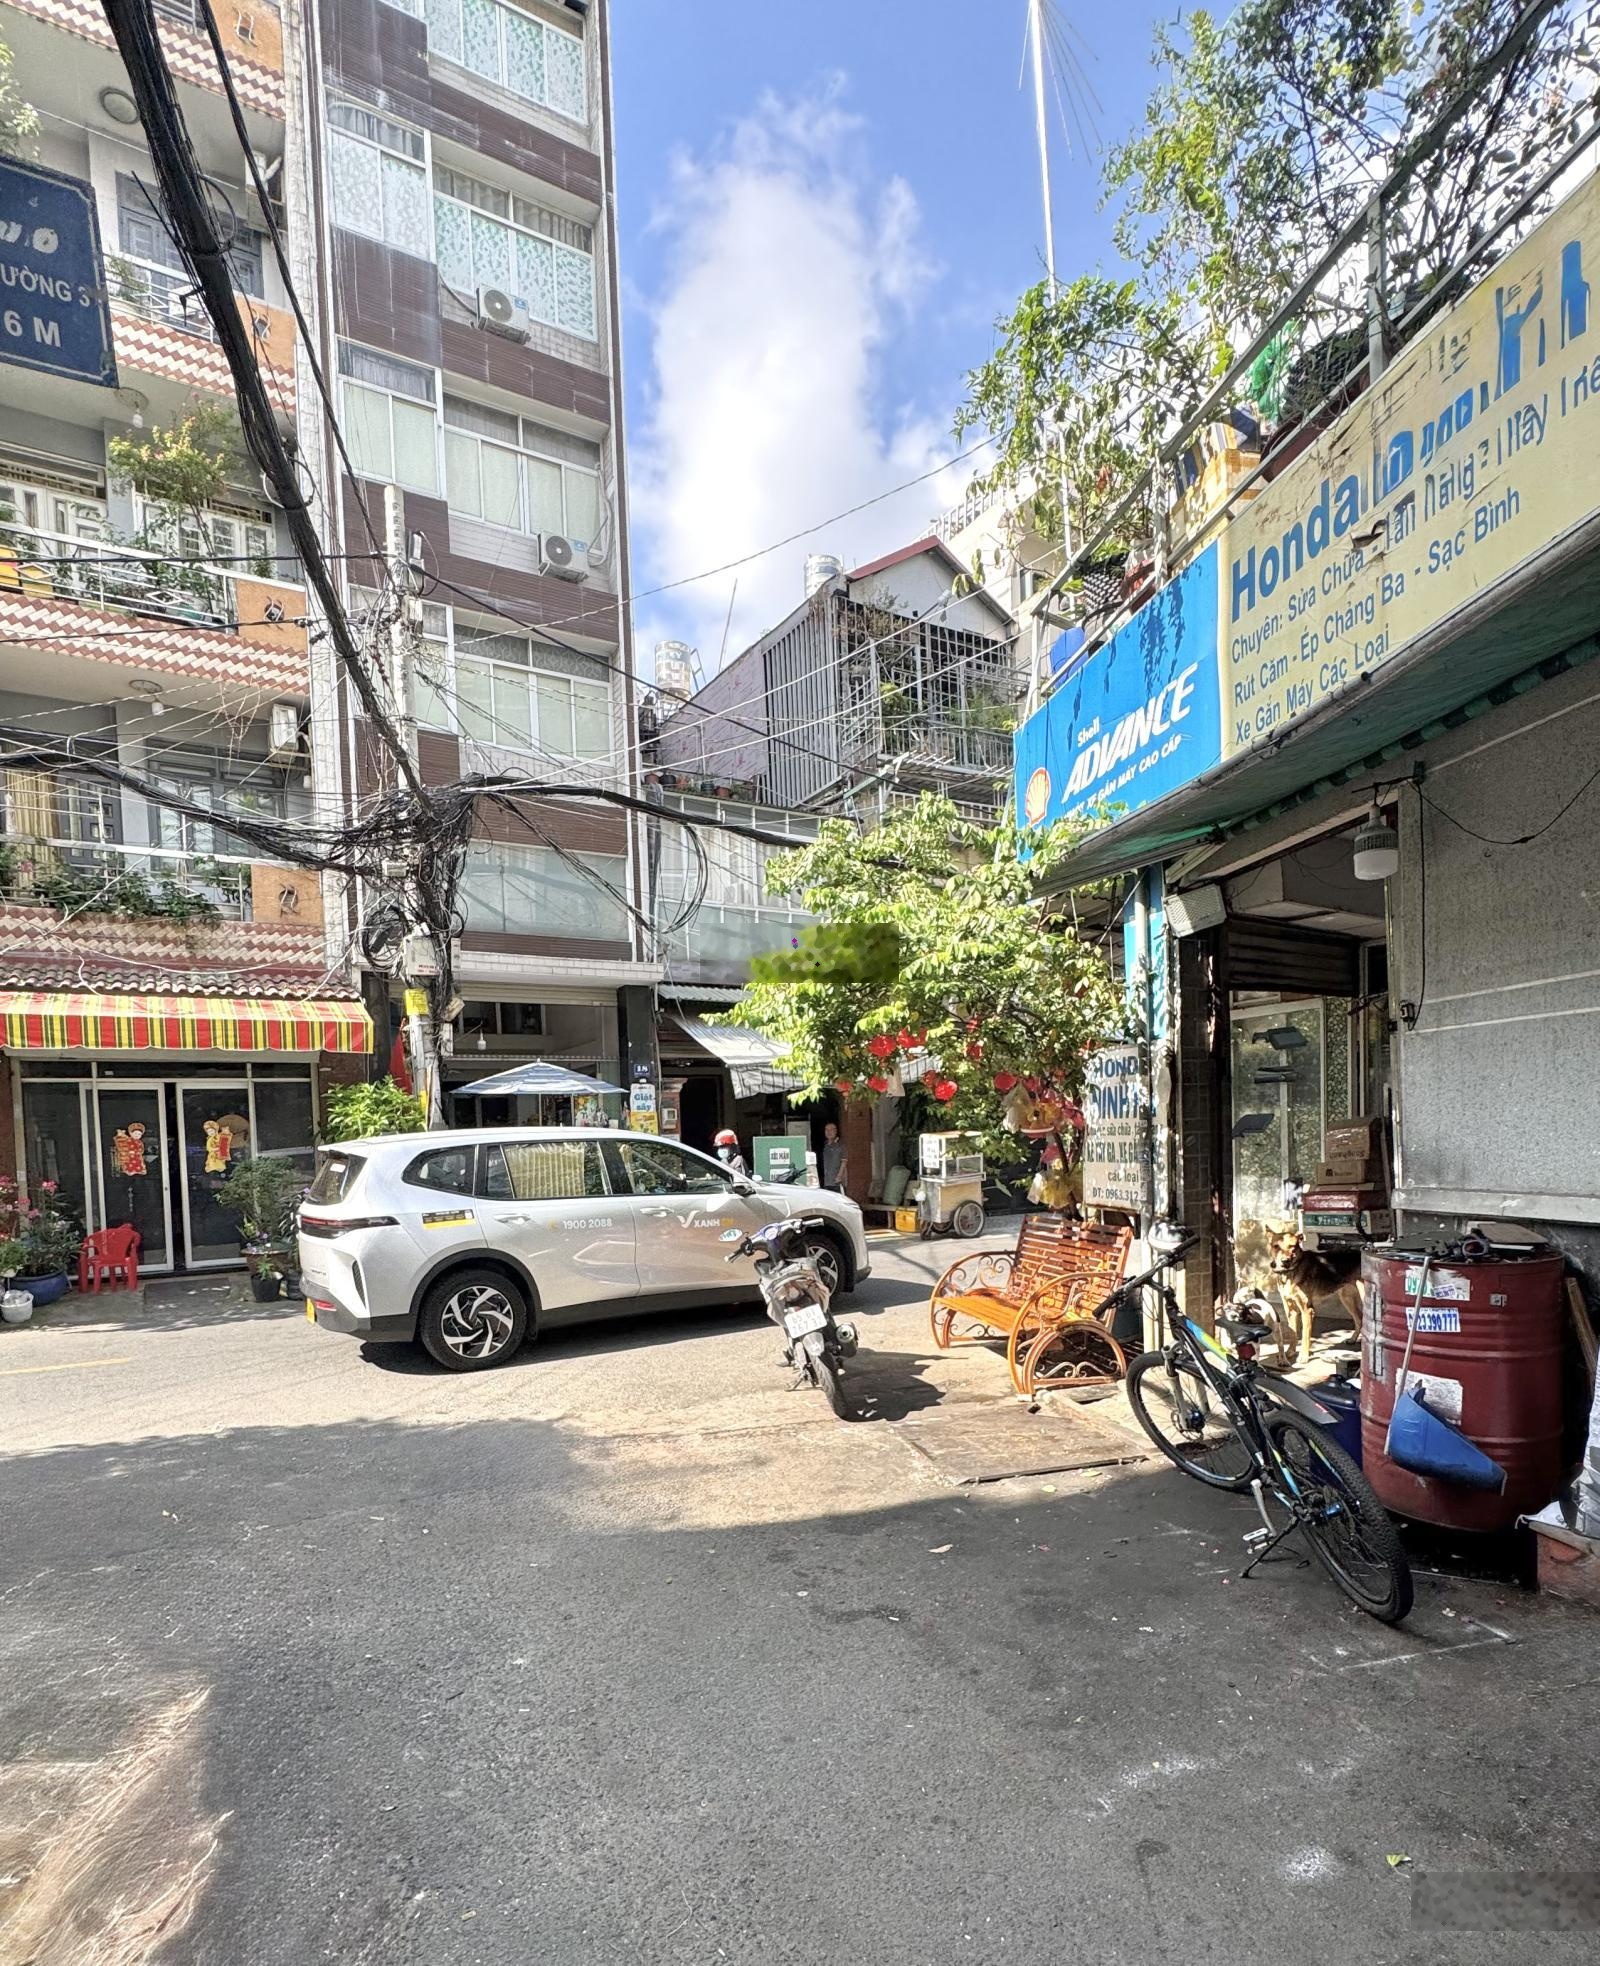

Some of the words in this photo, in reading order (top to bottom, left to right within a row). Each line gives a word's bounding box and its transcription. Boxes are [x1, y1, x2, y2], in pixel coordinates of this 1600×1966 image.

[0, 262, 72, 303] ƯỜNG
[78, 286, 90, 307] 3
[33, 317, 62, 348] M
[1231, 473, 1361, 624] Honda
[1231, 613, 1283, 664] Chuyên:
[1288, 585, 1316, 622] Sửa
[1321, 548, 1364, 596] Chữa
[1234, 673, 1256, 708] Rút
[1259, 656, 1289, 690] Căm
[1301, 625, 1319, 663] Ép
[1381, 572, 1405, 606] Ba
[1428, 529, 1466, 575] Sạc
[1474, 485, 1520, 544] Bình
[1235, 719, 1251, 746] Xe
[1286, 678, 1314, 714] Máy
[1319, 655, 1348, 691] Các
[1354, 623, 1389, 670] Loại
[1061, 661, 1199, 804] ADVANCE
[1077, 716, 1100, 748] Shell
[1138, 749, 1160, 773] CAO
[635, 1064, 649, 1073] 18
[1095, 1055, 1139, 1078] HOND
[563, 1219, 587, 1230] 1900
[694, 1219, 720, 1228] XANH
